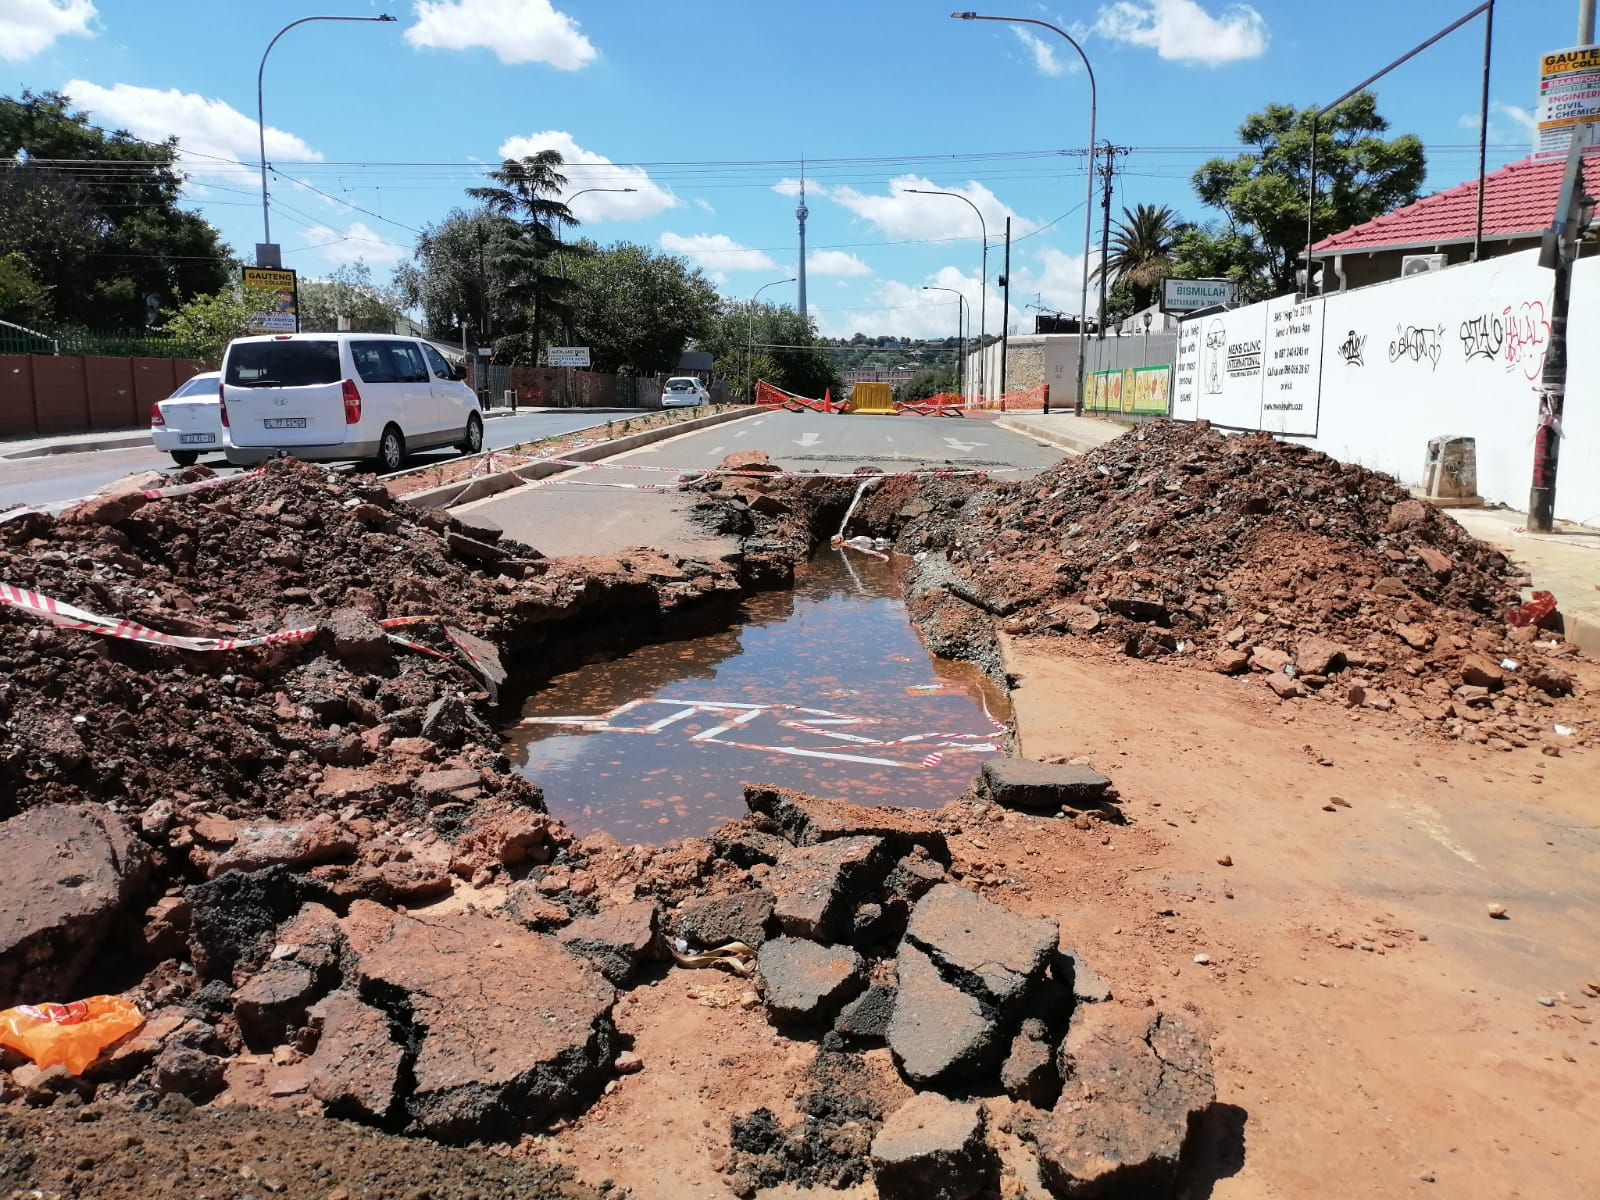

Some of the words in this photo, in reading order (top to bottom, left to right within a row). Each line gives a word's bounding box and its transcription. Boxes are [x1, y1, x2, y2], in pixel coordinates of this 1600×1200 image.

[1545, 62, 1569, 73] CITY
[1556, 101, 1584, 111] CIVIL
[248, 272, 292, 281] GAUTENG
[1176, 286, 1226, 297] BISMILLAH
[1504, 314, 1544, 346] HALAL
[1243, 339, 1261, 353] CLINIC
[1227, 355, 1260, 369] INTERNATIONAL
